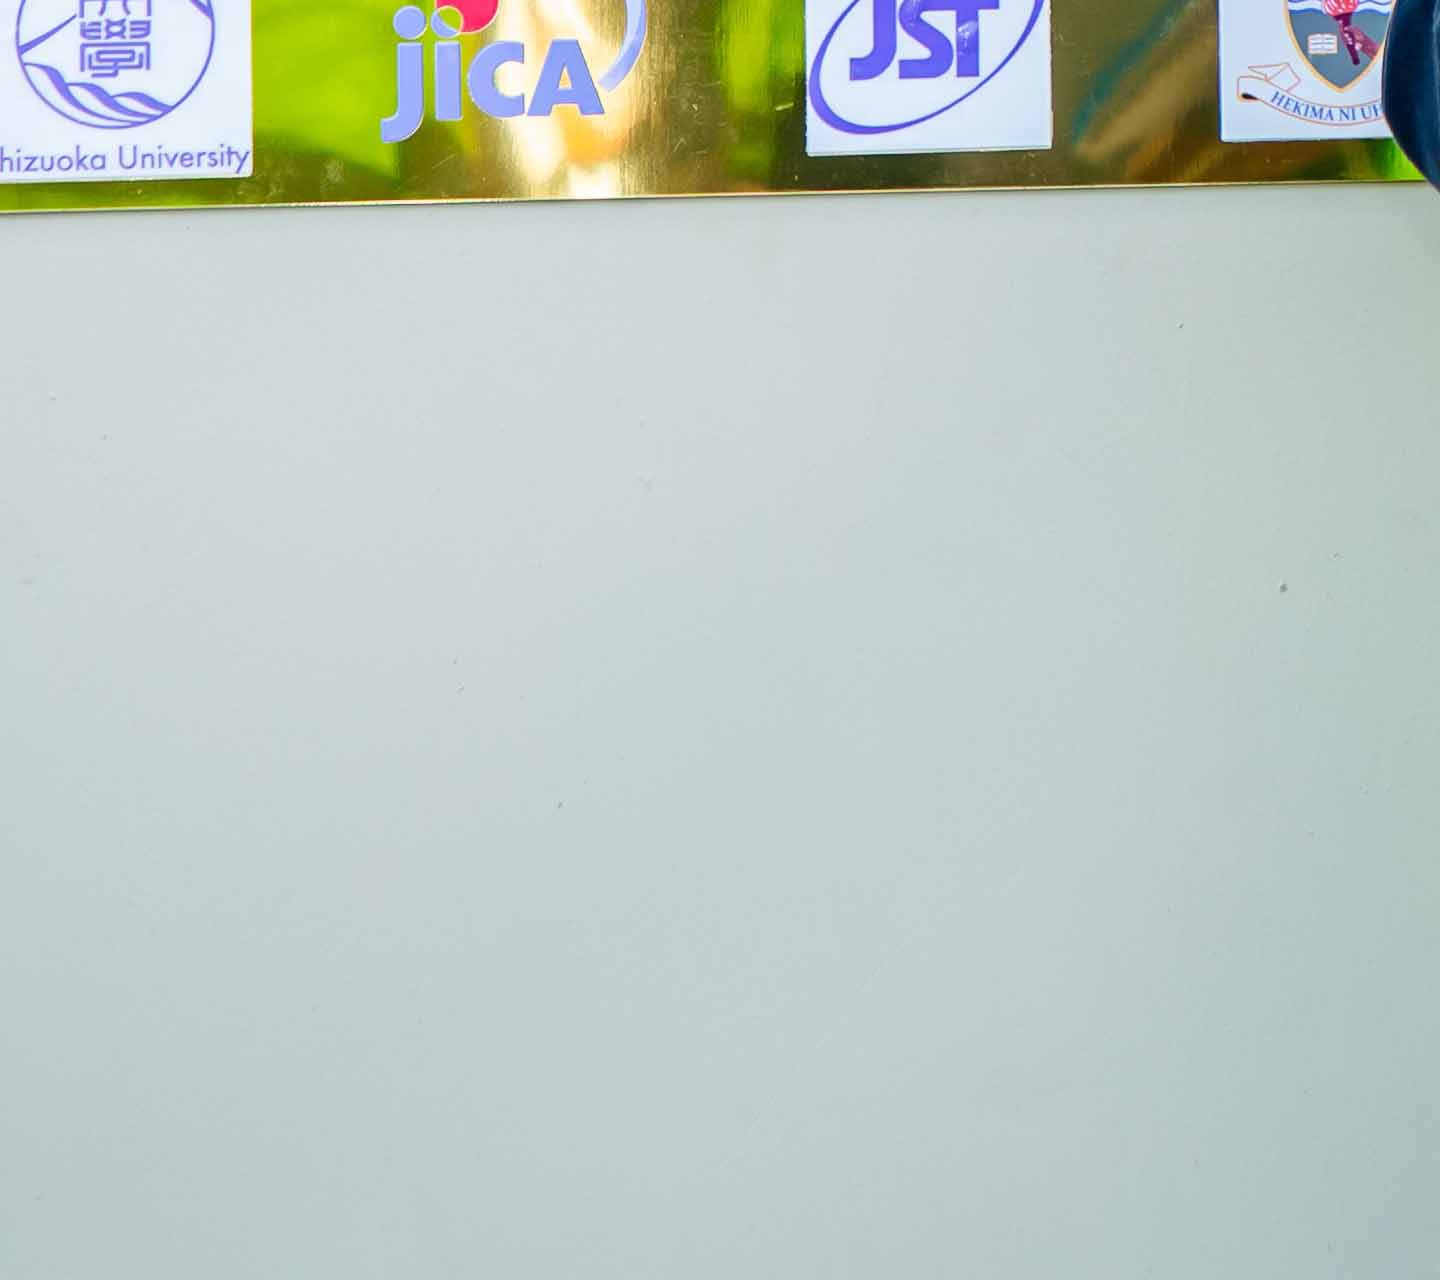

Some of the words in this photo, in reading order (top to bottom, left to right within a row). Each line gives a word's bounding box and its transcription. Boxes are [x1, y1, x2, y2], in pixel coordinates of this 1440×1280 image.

[1271, 91, 1334, 121] HEKIMA
[1339, 108, 1356, 121] NI
[118, 143, 250, 174] University
